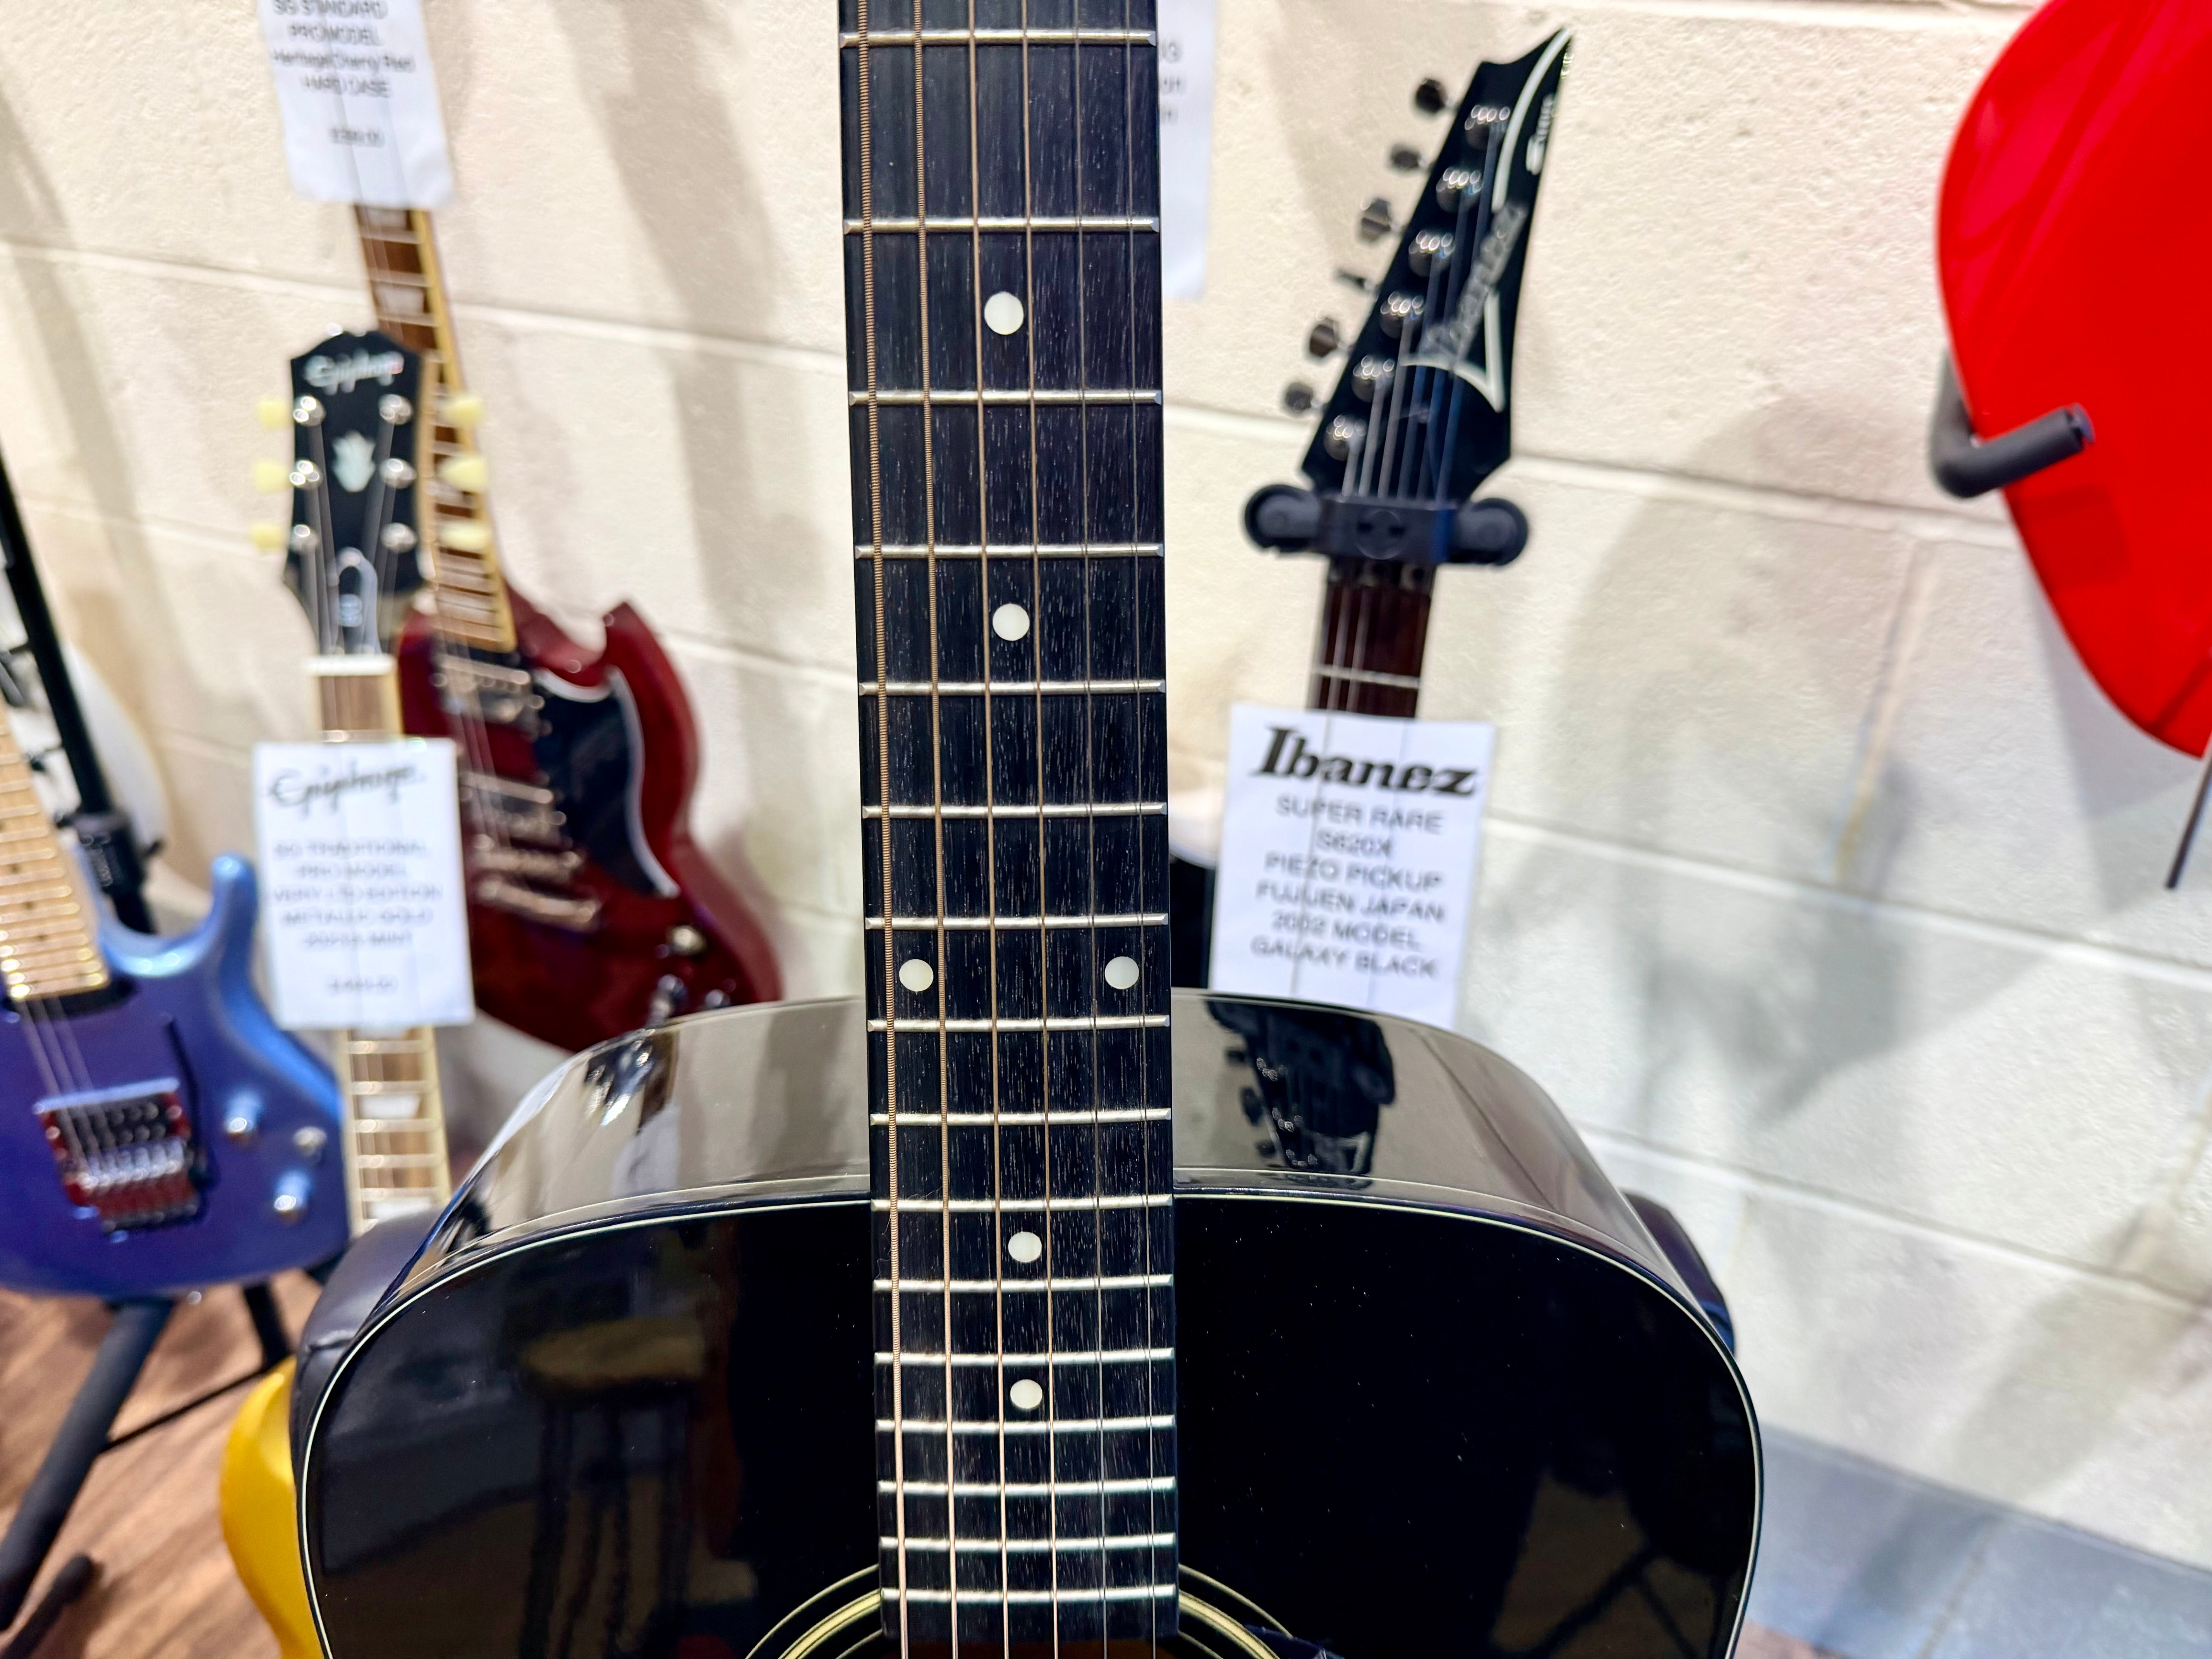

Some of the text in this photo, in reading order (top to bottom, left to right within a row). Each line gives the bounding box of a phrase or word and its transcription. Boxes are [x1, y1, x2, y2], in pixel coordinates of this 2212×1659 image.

[1249, 725, 1479, 798] Ibanez
[1276, 793, 1444, 833] SUPER RARE
[1264, 851, 1443, 891] PIEZO PICKUP
[1361, 893, 1446, 922] JAPAN
[1332, 921, 1421, 951] MODEL
[1354, 951, 1439, 978] BLACK
